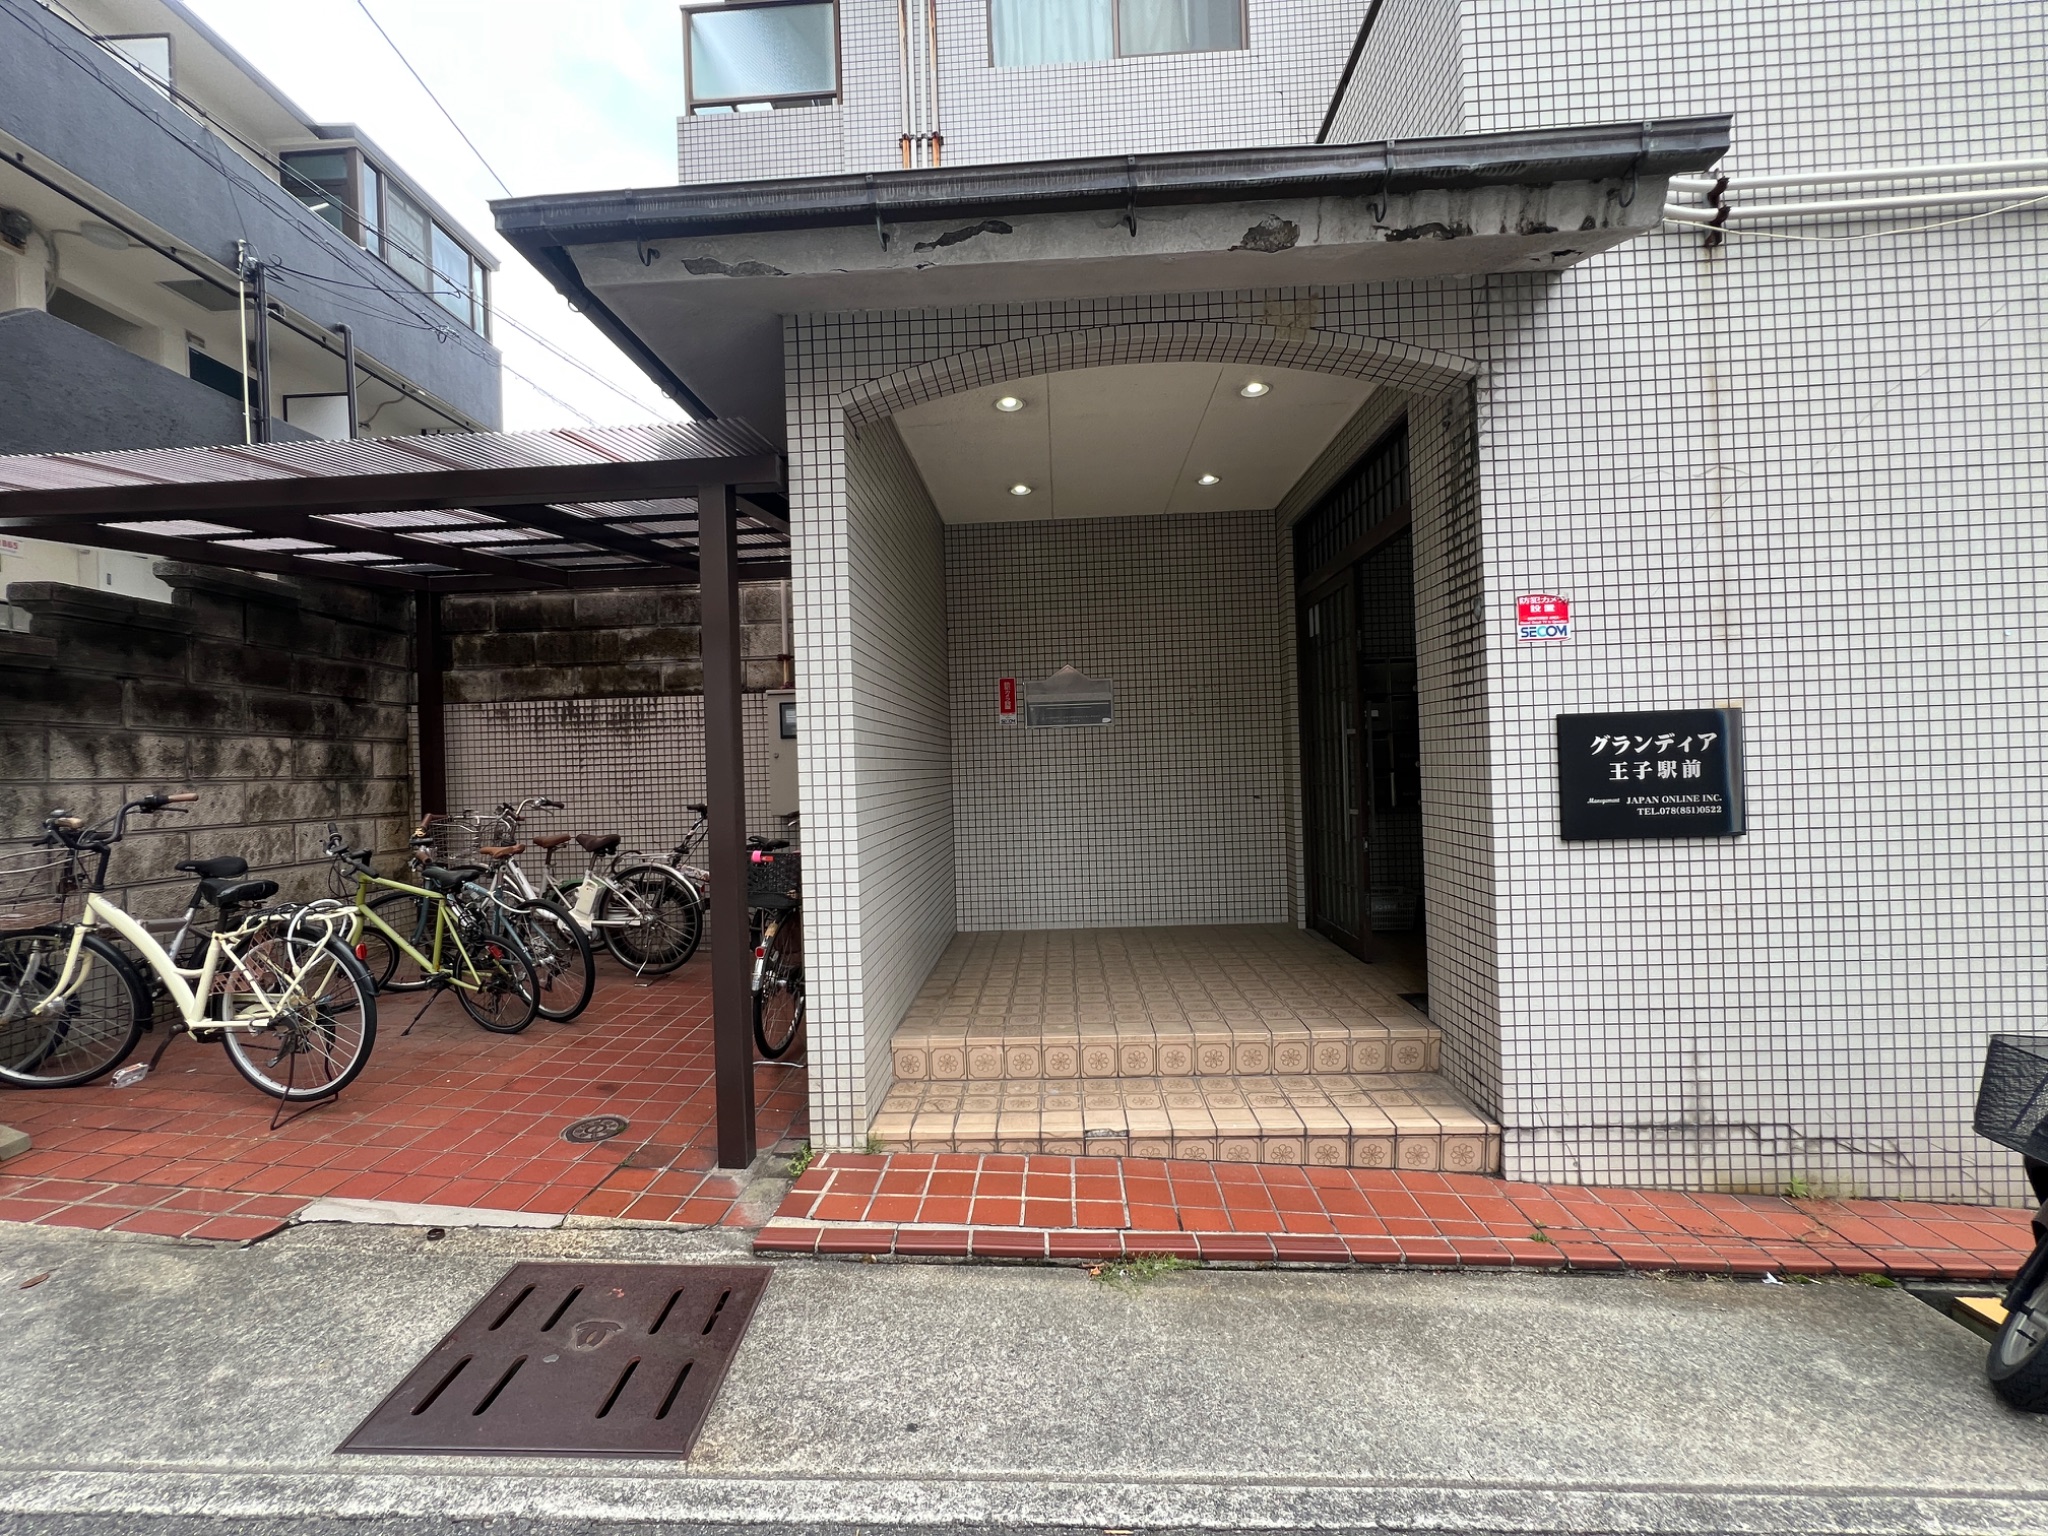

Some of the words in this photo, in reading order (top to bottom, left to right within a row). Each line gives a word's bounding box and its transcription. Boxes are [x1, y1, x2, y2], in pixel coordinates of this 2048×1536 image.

[1521, 625, 1567, 638] SECOM
[1590, 732, 1718, 756] グランディア
[1609, 759, 1702, 781] 王子駅前
[1626, 795, 1660, 805] JAPAN
[1661, 794, 1700, 804] ONLINE
[1702, 793, 1722, 802] INC.
[1637, 806, 1722, 816] TEL.078(851)0522
